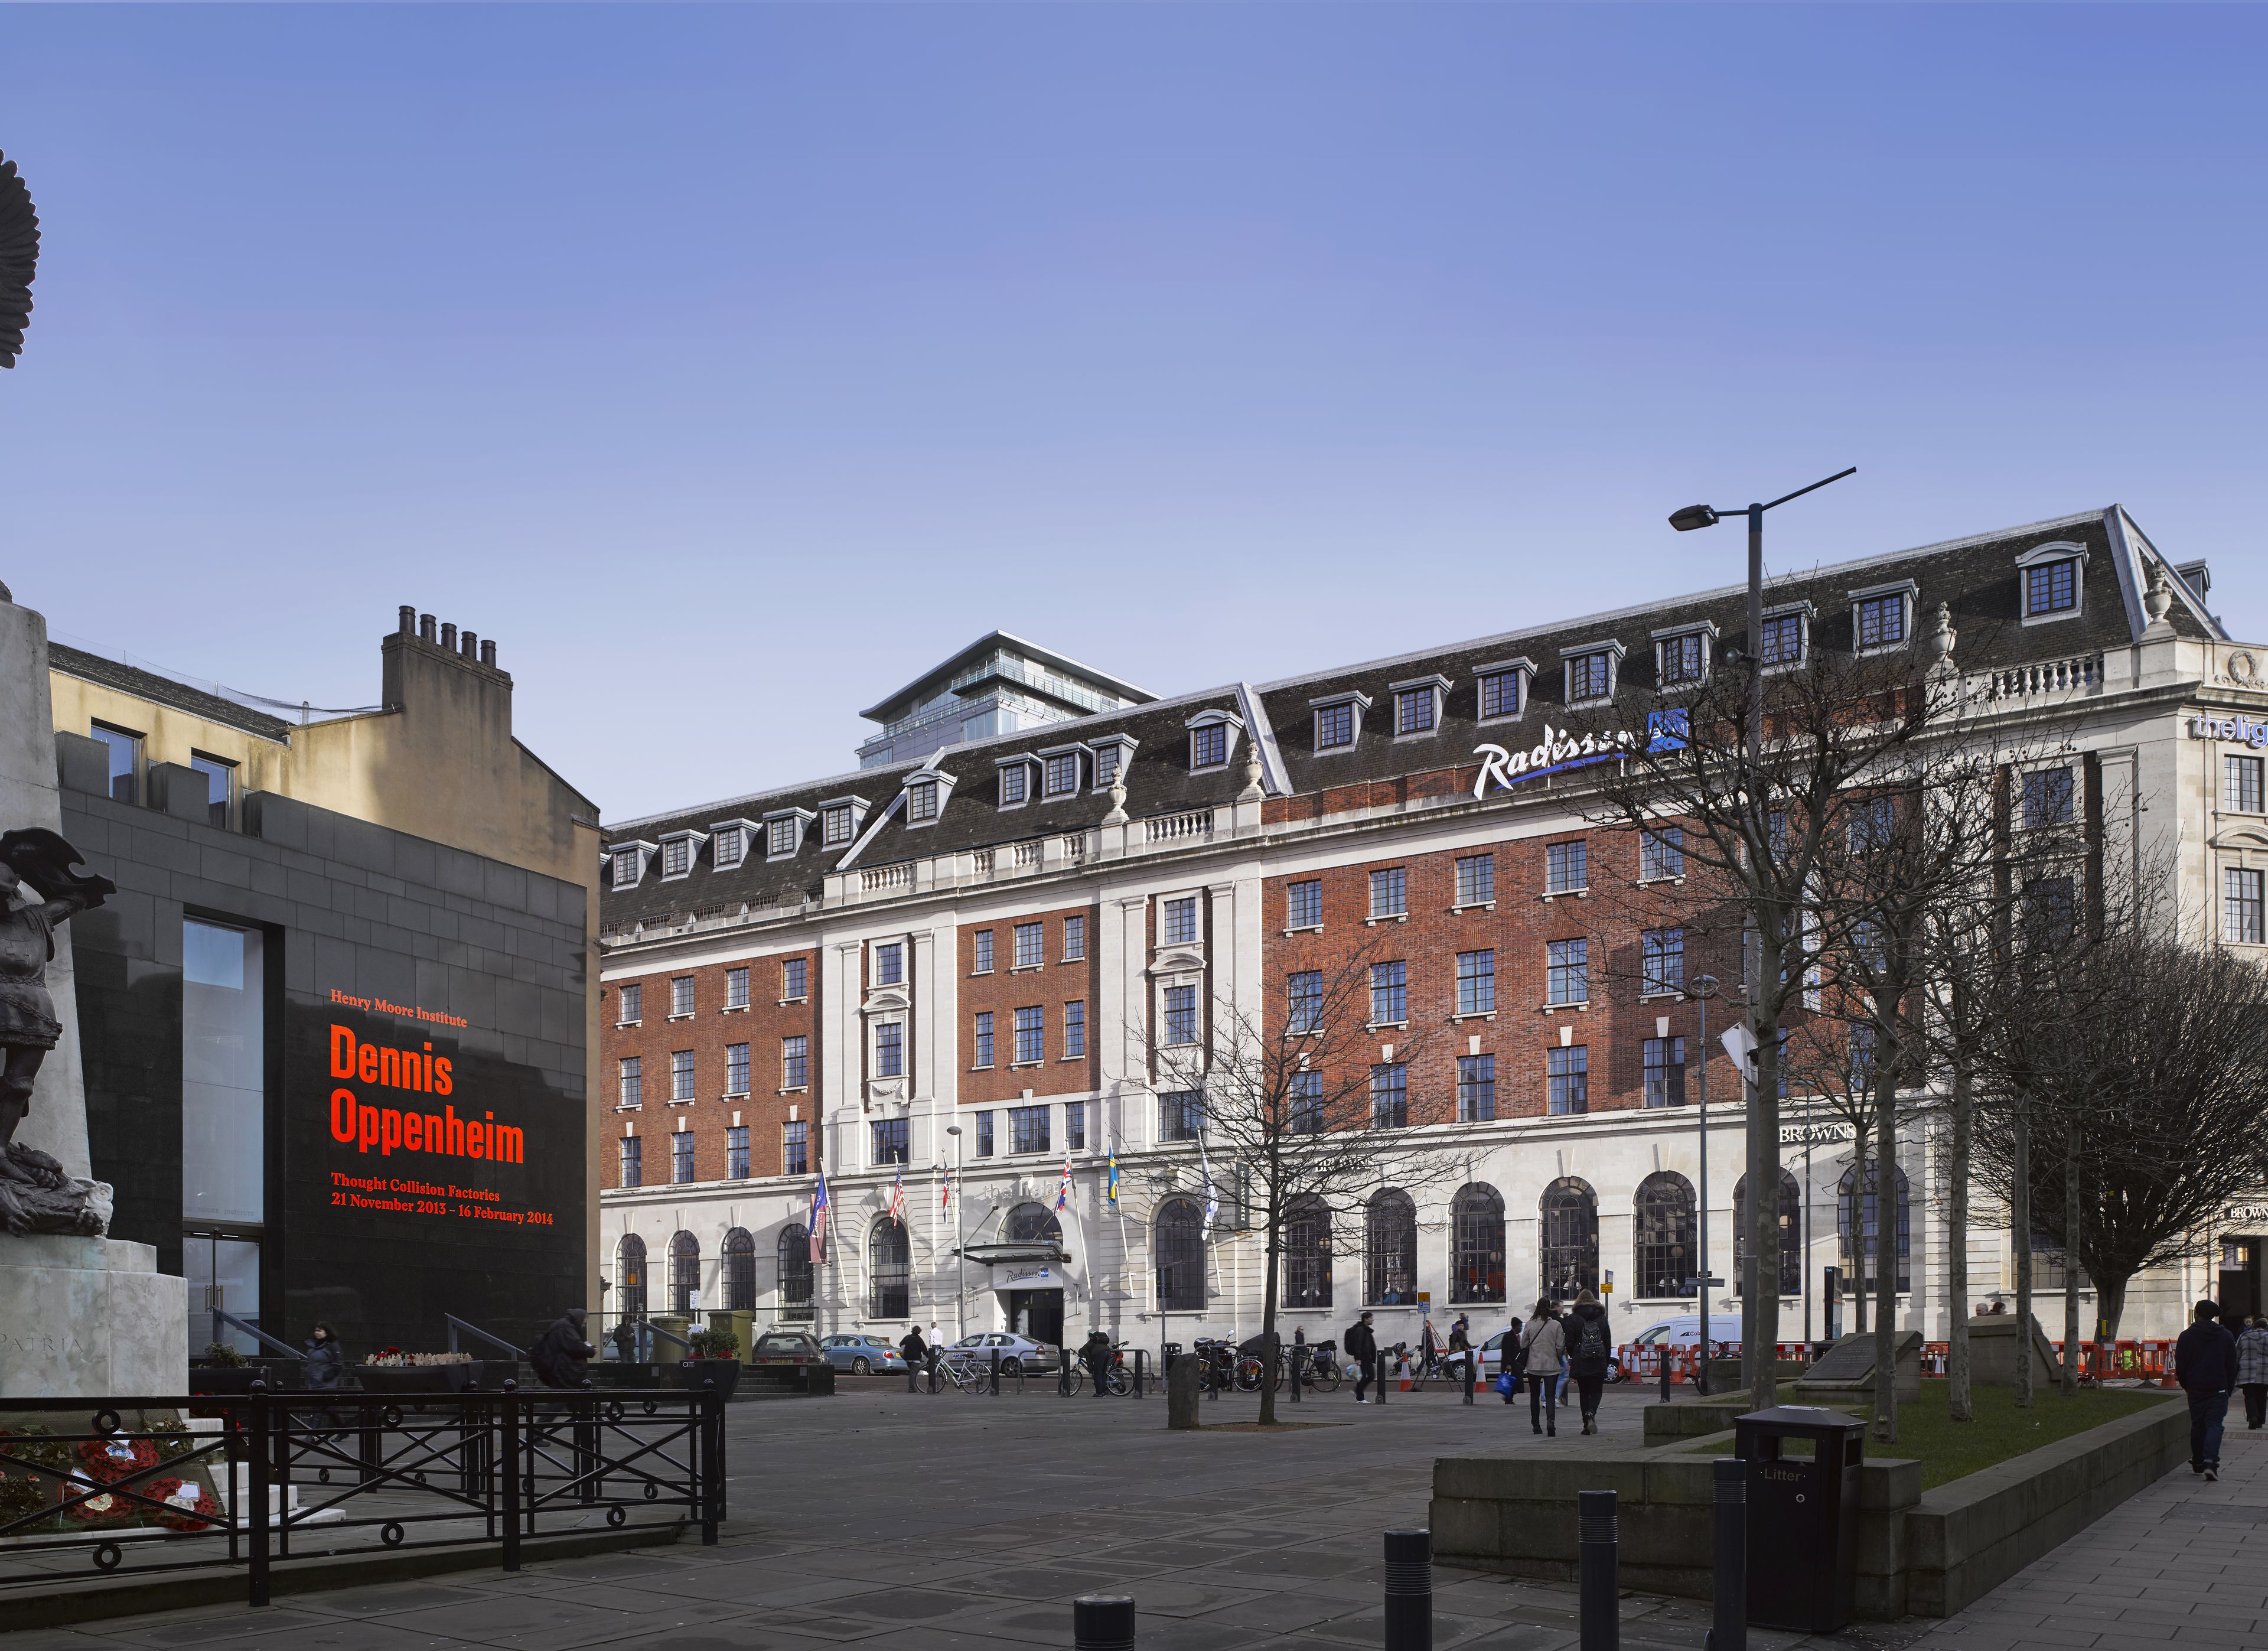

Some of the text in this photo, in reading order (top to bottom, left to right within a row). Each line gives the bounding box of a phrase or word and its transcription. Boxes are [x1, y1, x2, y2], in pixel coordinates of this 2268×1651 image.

[1473, 724, 1642, 800] Radisson
[331, 988, 468, 1028] Henry Moore Institute
[330, 1024, 453, 1096] Dennis
[330, 1088, 524, 1164] Oppenheim
[1779, 1124, 1857, 1142] BROWNS
[330, 1171, 500, 1203] Thought Collision Factories
[331, 1191, 347, 1206] 21
[350, 1193, 415, 1212] November
[416, 1199, 447, 1216] 2013
[458, 1204, 472, 1218] 16
[474, 1206, 524, 1226] February
[526, 1210, 553, 1225] 2014
[1006, 1268, 1040, 1283] Radisson
[1764, 1467, 1801, 1482] Litter
